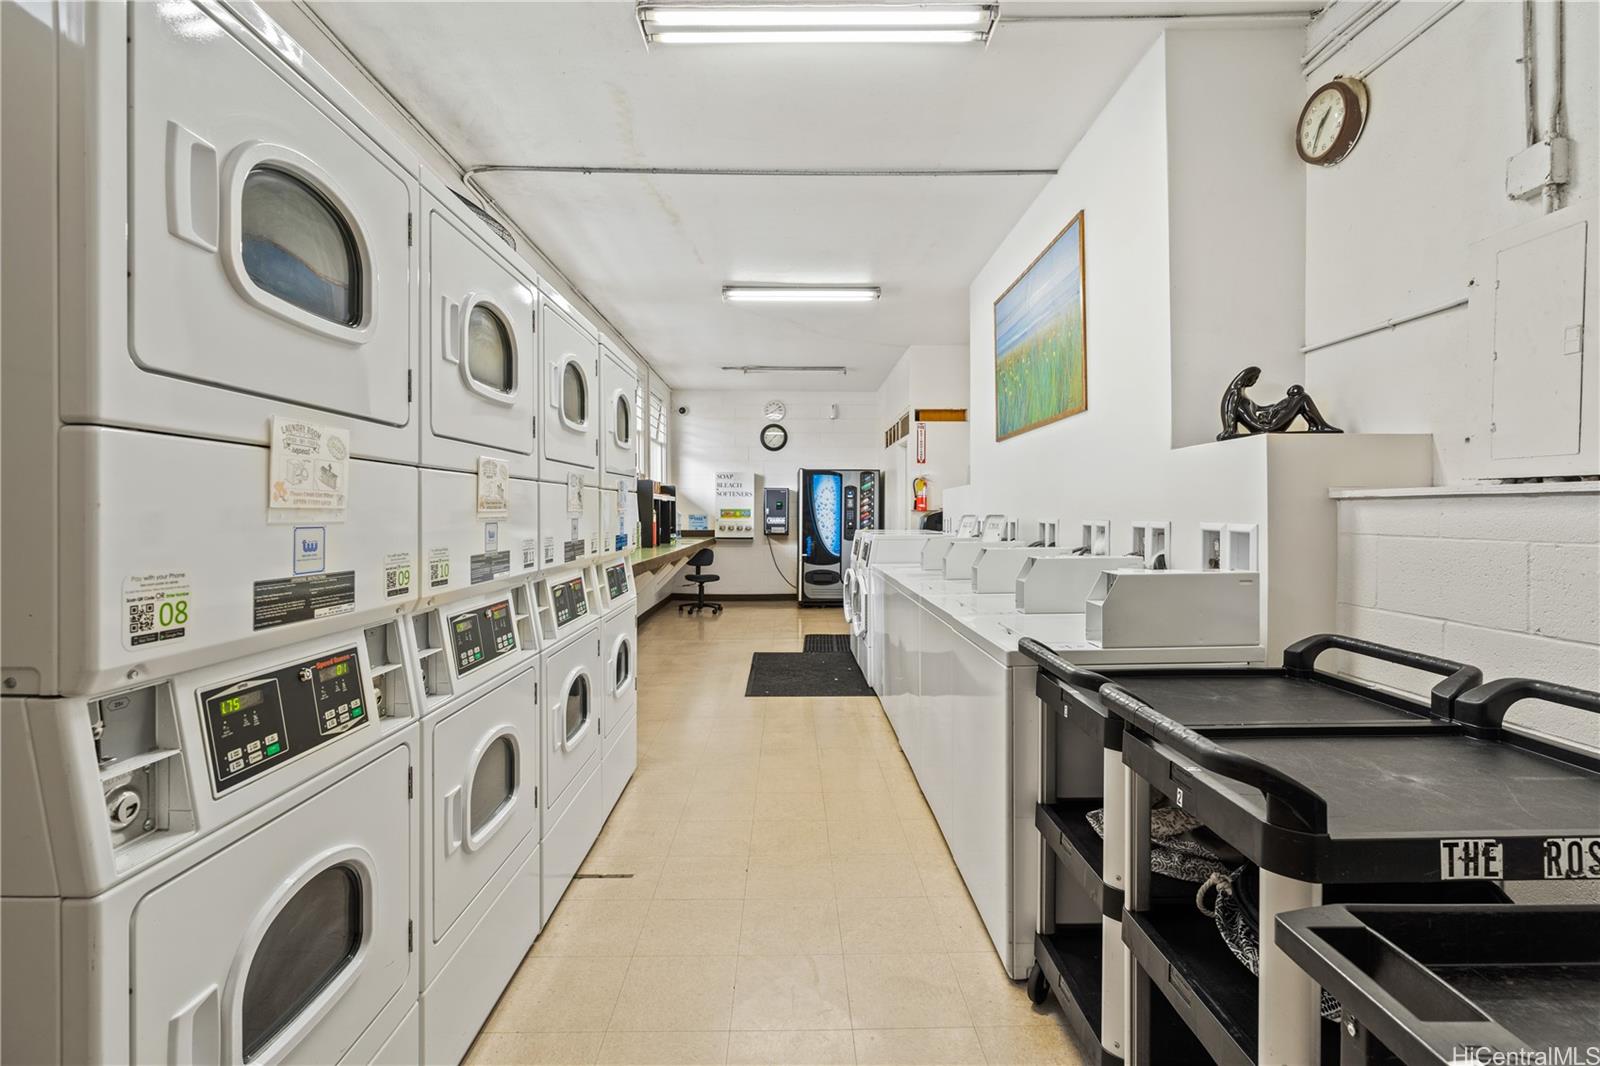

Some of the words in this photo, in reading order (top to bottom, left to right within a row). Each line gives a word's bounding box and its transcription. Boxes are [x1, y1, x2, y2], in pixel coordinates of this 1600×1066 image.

[398, 570, 410, 586] 09
[440, 563, 449, 578] 10
[159, 600, 188, 627] 08
[1442, 841, 1499, 877] THE
[1546, 840, 1600, 877] ROS
